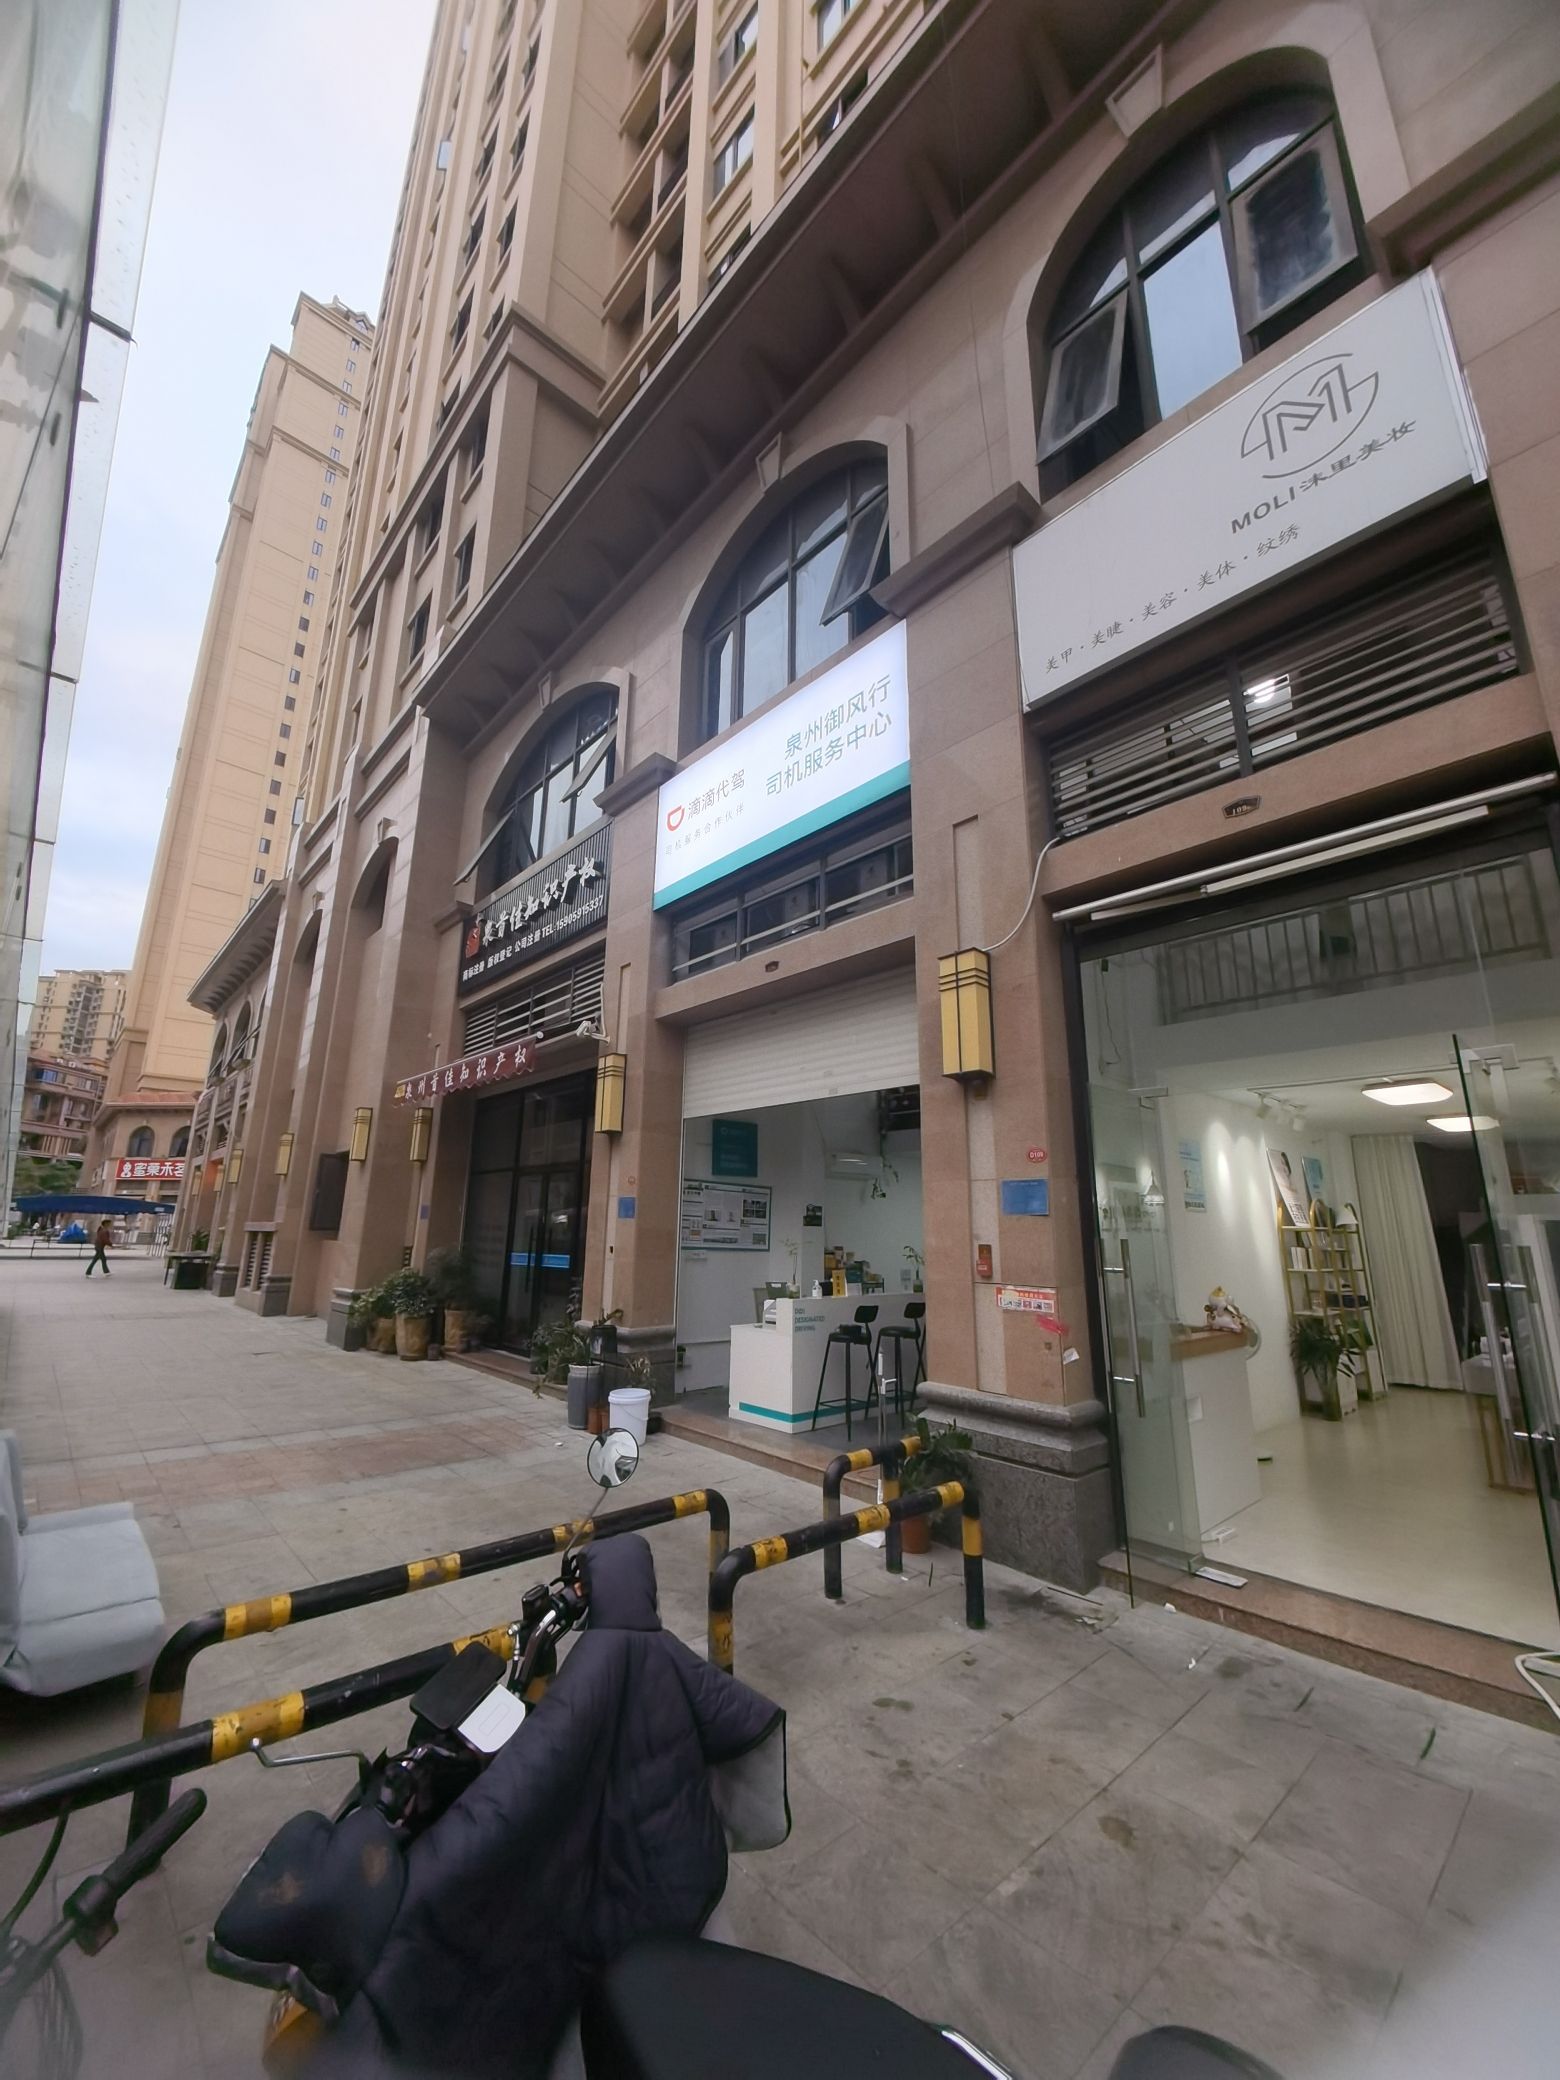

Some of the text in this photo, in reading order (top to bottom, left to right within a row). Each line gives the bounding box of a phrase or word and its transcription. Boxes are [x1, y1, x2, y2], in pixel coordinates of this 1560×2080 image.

[1231, 486, 1296, 534] MOLI
[784, 674, 891, 760] 泉州御风行
[765, 711, 893, 797] 司机服务中心
[687, 768, 745, 821] 滴滴代驾
[514, 929, 541, 952] 公司注册
